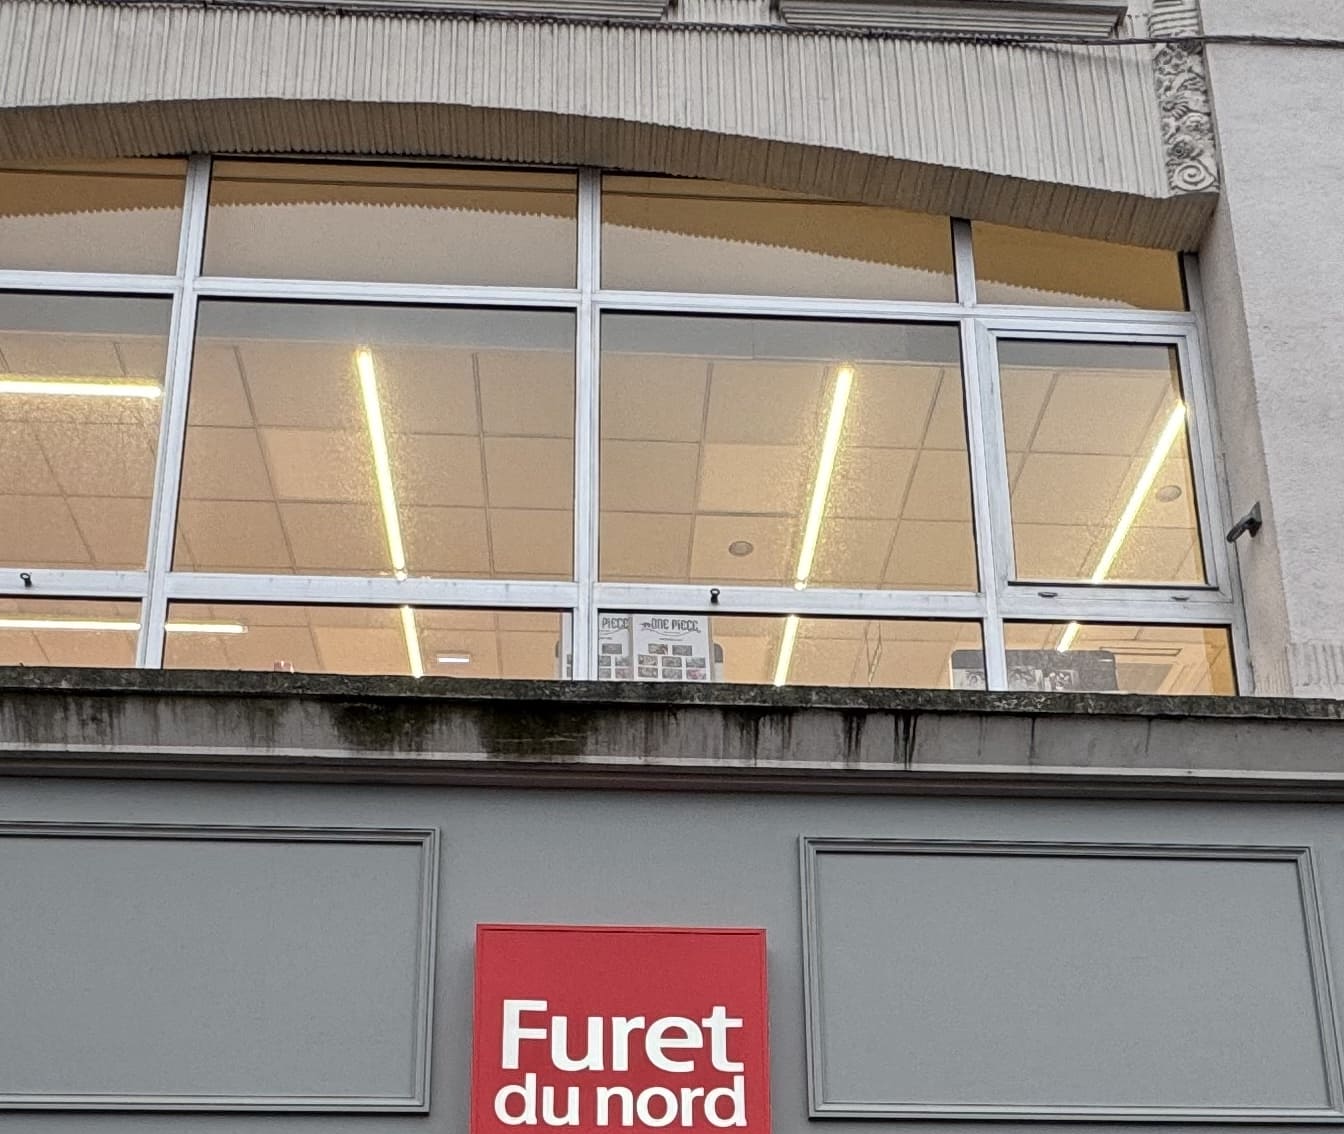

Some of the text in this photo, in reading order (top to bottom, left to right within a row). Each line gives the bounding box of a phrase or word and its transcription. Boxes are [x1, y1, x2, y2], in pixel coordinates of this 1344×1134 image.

[651, 617, 700, 632] ONE PIECE
[501, 999, 745, 1073] Furet
[494, 1072, 748, 1128] du nord
